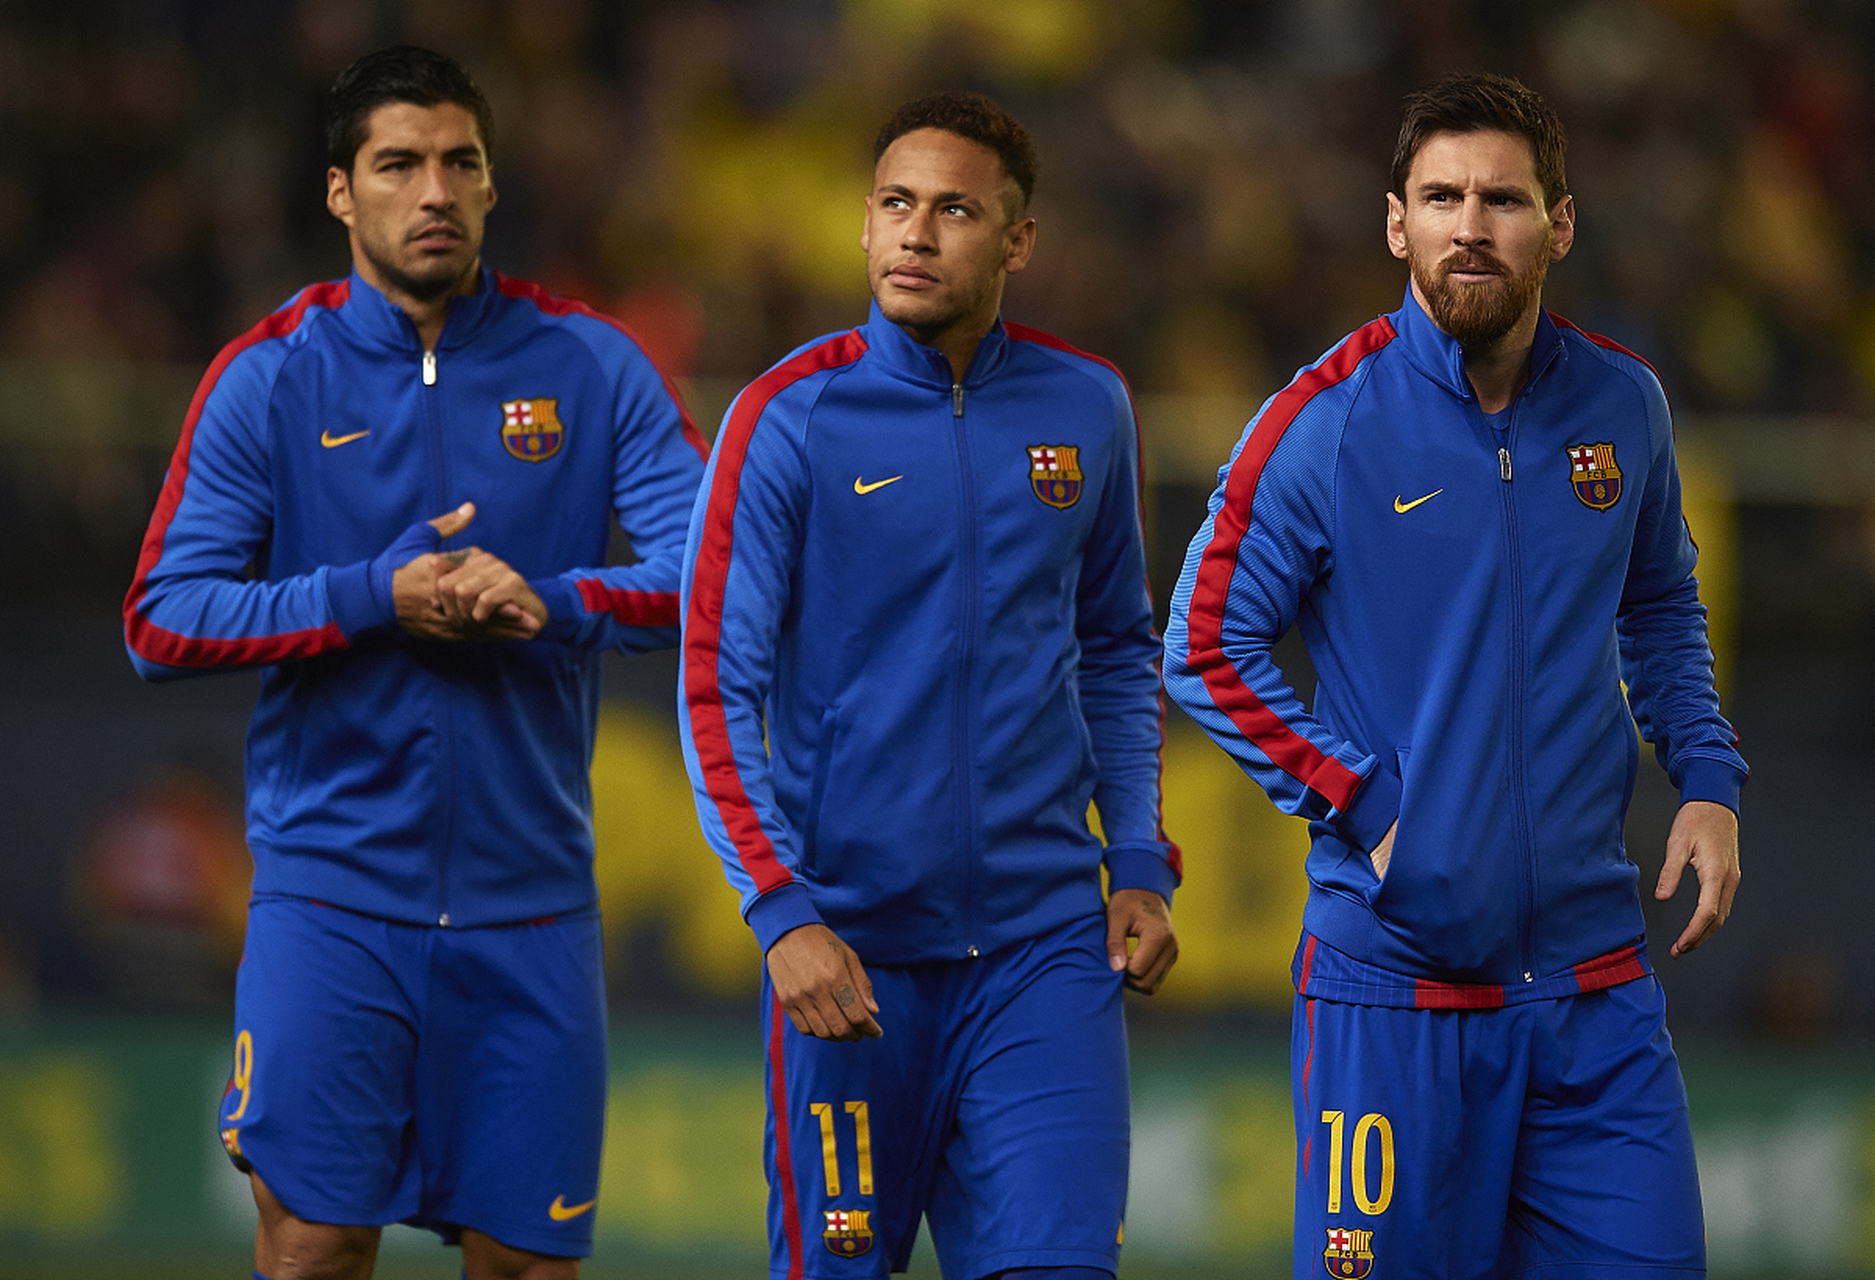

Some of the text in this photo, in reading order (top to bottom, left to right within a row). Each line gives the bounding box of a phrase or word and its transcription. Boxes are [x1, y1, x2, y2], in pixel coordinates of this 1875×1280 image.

[1587, 470, 1607, 480] FCB
[226, 1029, 253, 1121] 9
[809, 1100, 874, 1198] 11
[1321, 1110, 1395, 1216] 10
[1338, 1250, 1358, 1259] FCB
